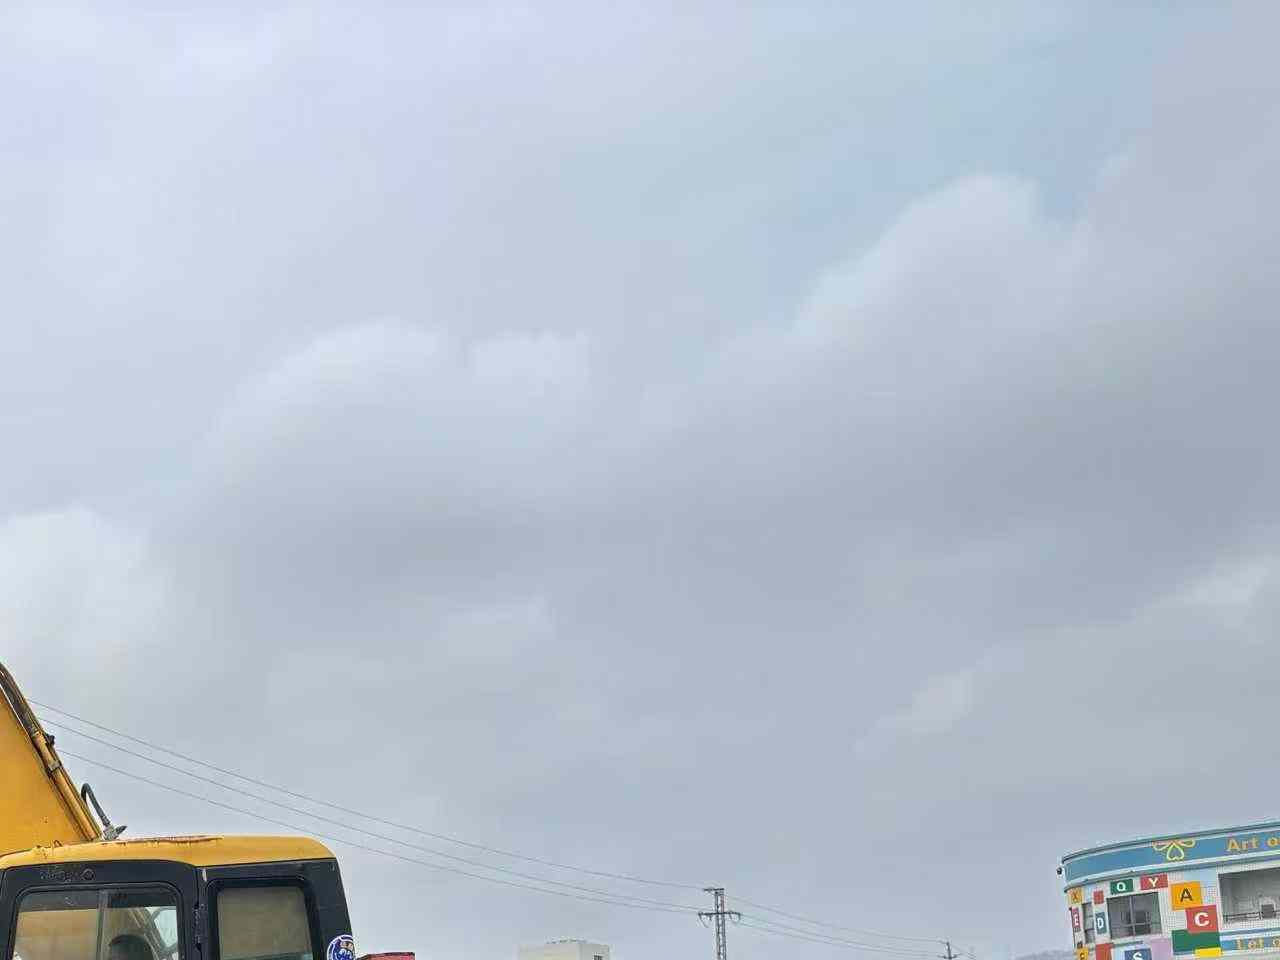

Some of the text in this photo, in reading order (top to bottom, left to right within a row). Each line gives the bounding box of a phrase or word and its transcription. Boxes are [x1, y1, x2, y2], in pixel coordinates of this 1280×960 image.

[1226, 838, 1258, 851] Art
[1148, 877, 1159, 888] Y
[1179, 888, 1194, 902] A
[1194, 912, 1210, 927] C
